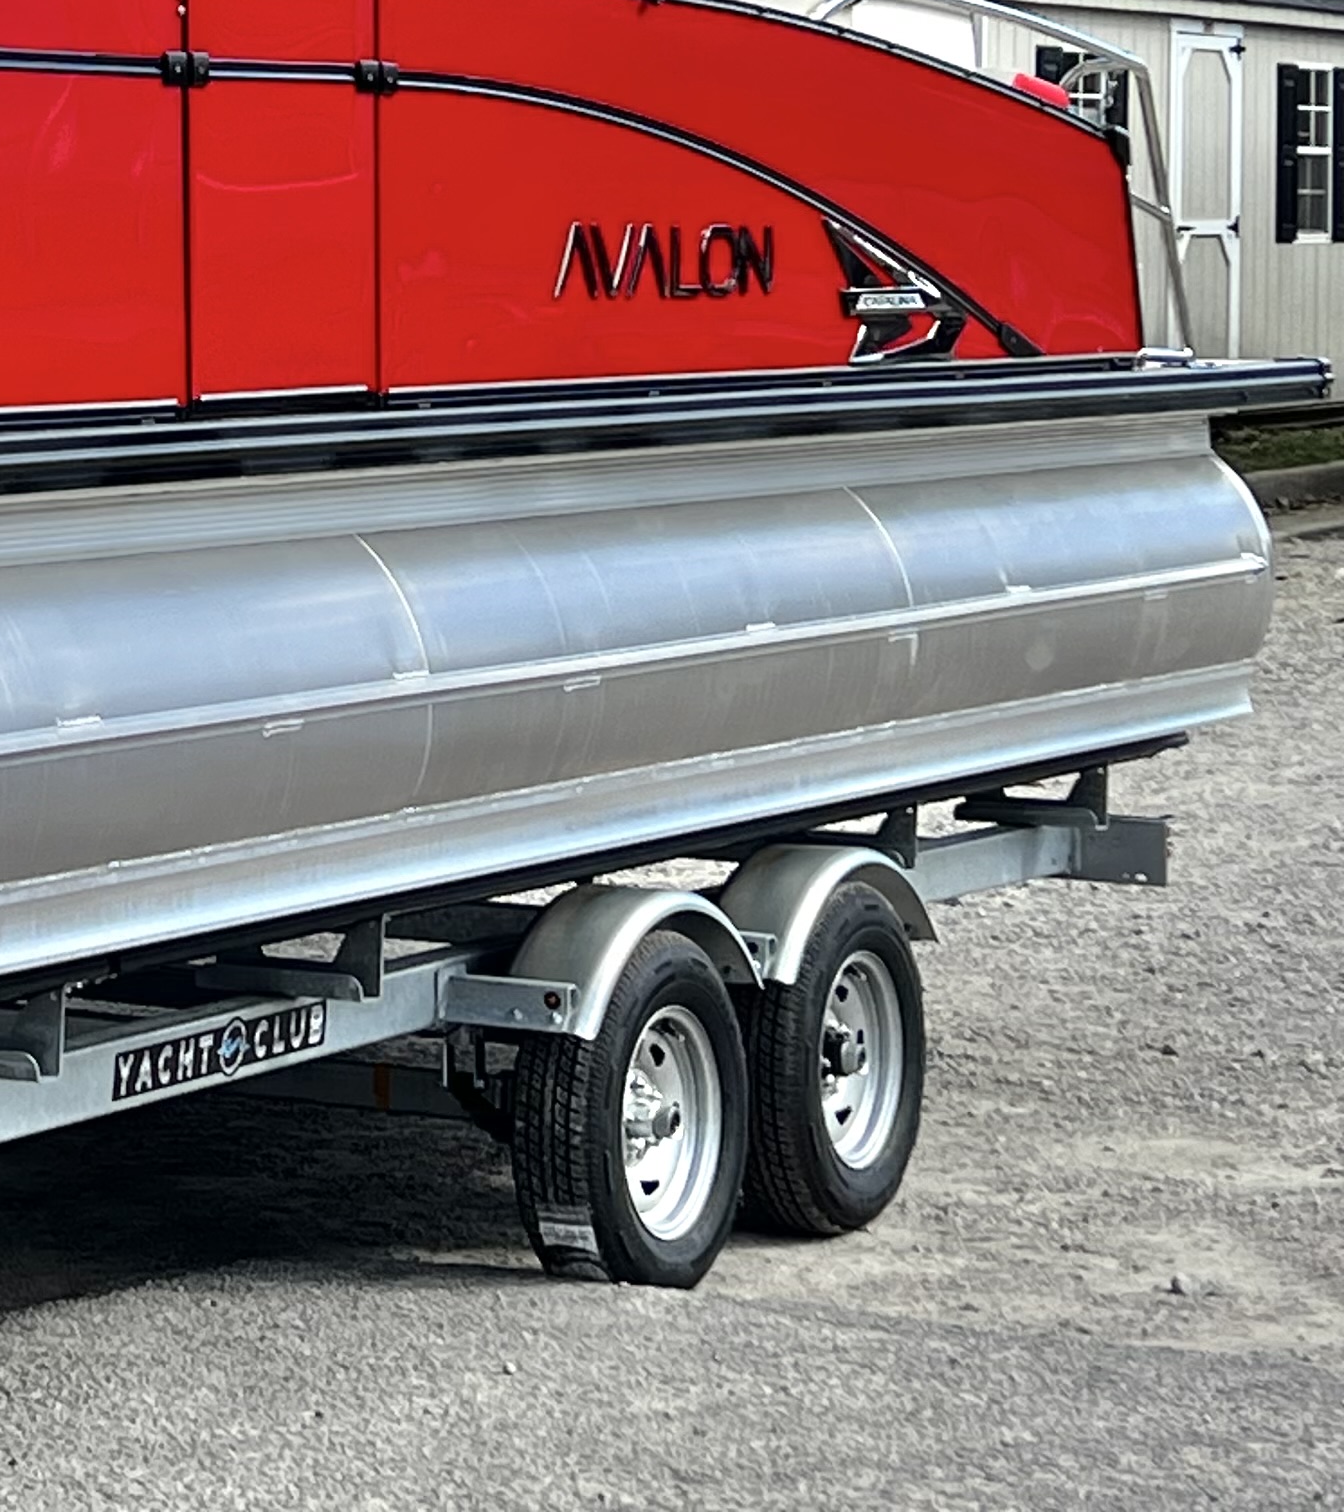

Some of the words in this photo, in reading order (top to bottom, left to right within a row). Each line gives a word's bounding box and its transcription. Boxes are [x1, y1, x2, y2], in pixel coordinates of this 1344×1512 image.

[553, 221, 775, 299] AVALON
[118, 1034, 214, 1096] YACHT
[253, 1004, 323, 1059] CLUB
